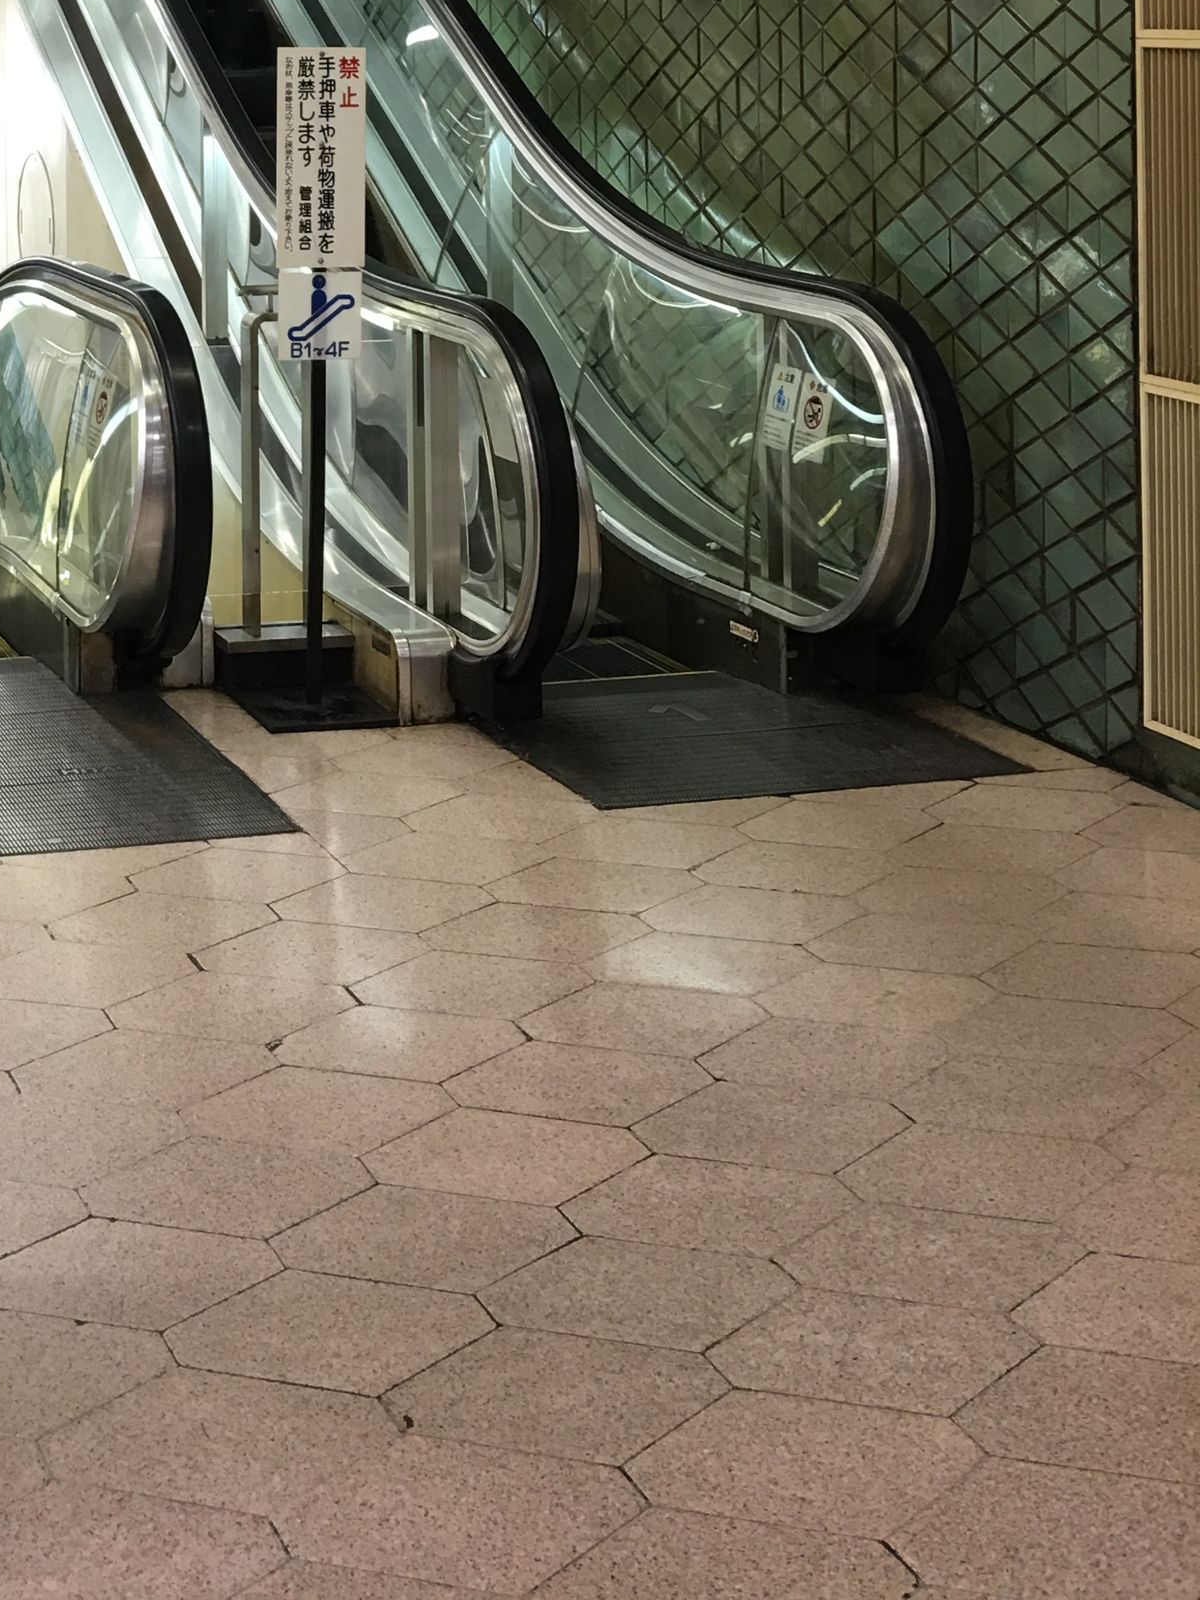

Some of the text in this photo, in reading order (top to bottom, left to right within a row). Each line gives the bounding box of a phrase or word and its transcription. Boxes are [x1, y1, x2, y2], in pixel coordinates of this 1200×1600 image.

[297, 56, 316, 251] 厳禁します 管理組合
[317, 56, 337, 254] 手押車や荷物運搬を
[338, 56, 360, 108] 禁止
